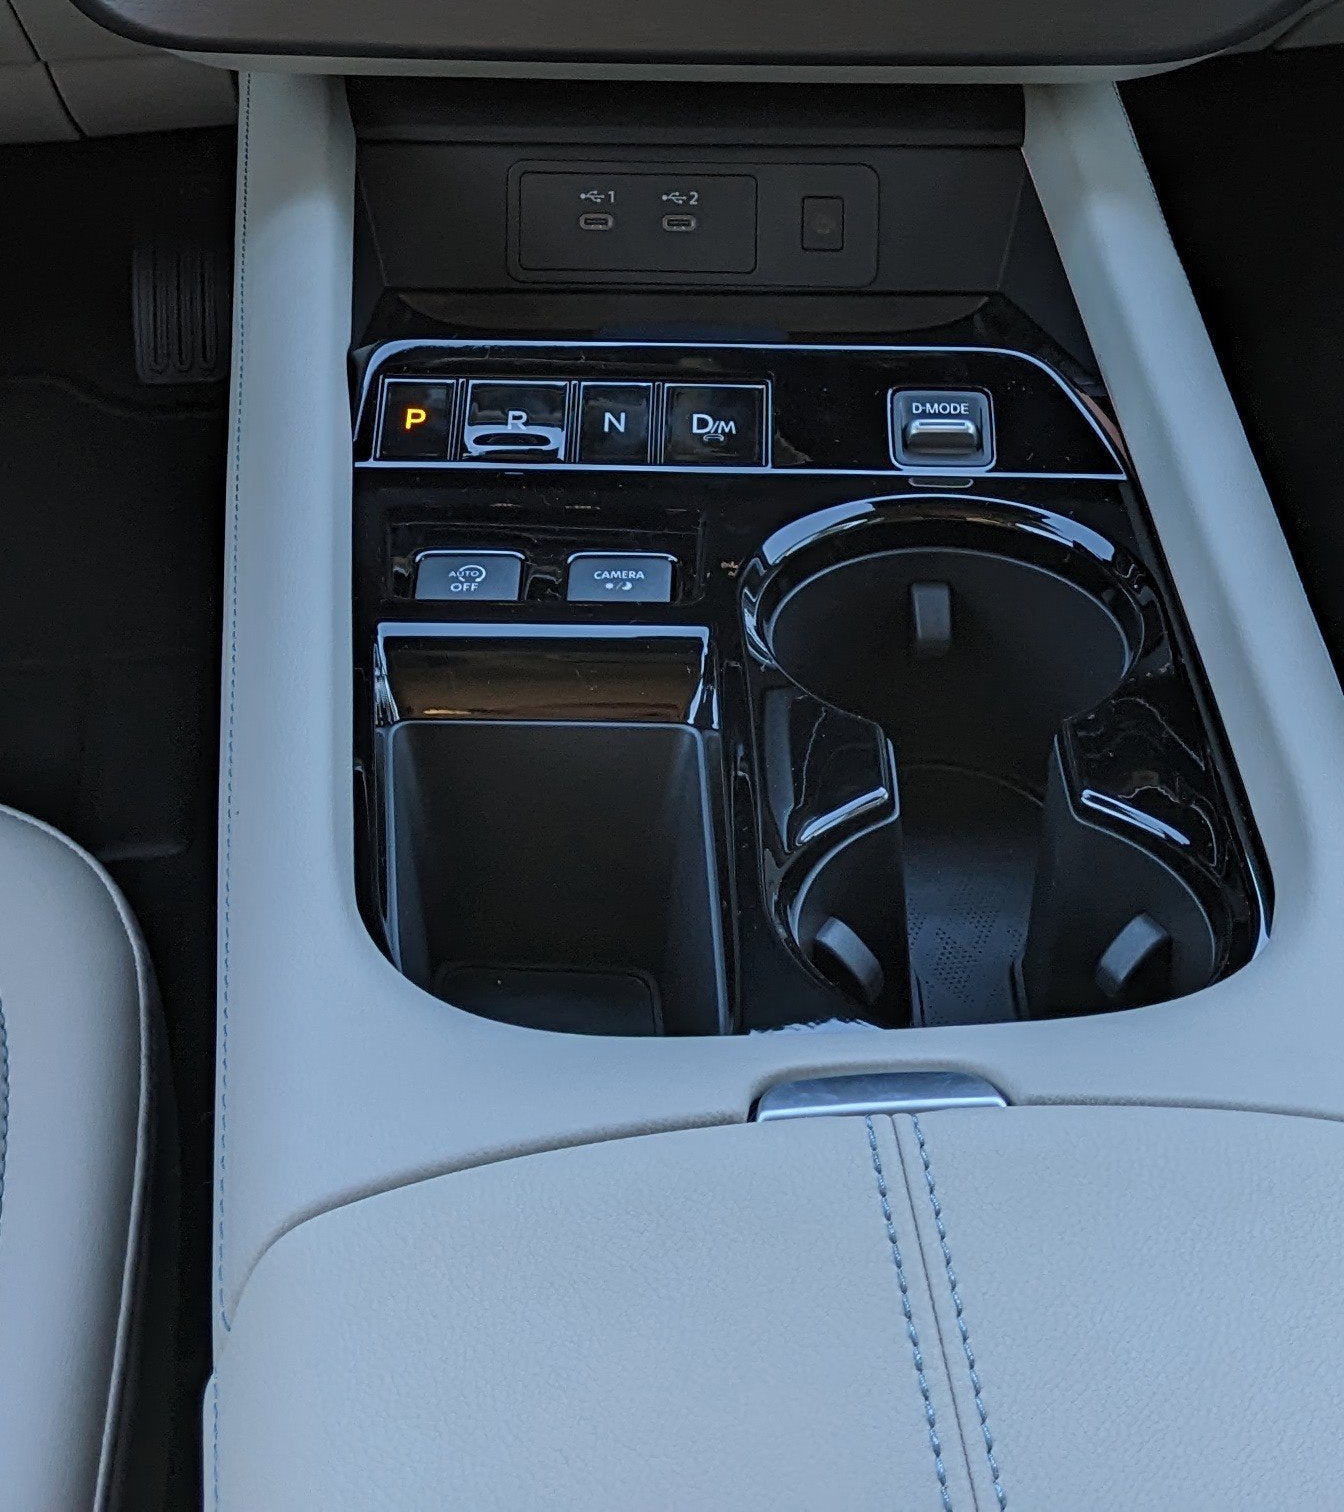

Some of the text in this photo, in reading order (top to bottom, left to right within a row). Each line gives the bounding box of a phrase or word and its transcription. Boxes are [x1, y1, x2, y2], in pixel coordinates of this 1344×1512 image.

[608, 190, 615, 203] 1
[689, 191, 699, 205] 2
[911, 402, 970, 415] D-MODE
[405, 408, 427, 430] P
[507, 410, 528, 431] R
[603, 412, 626, 433] N
[593, 570, 645, 580] CAMERA
[450, 582, 480, 592] OFF
